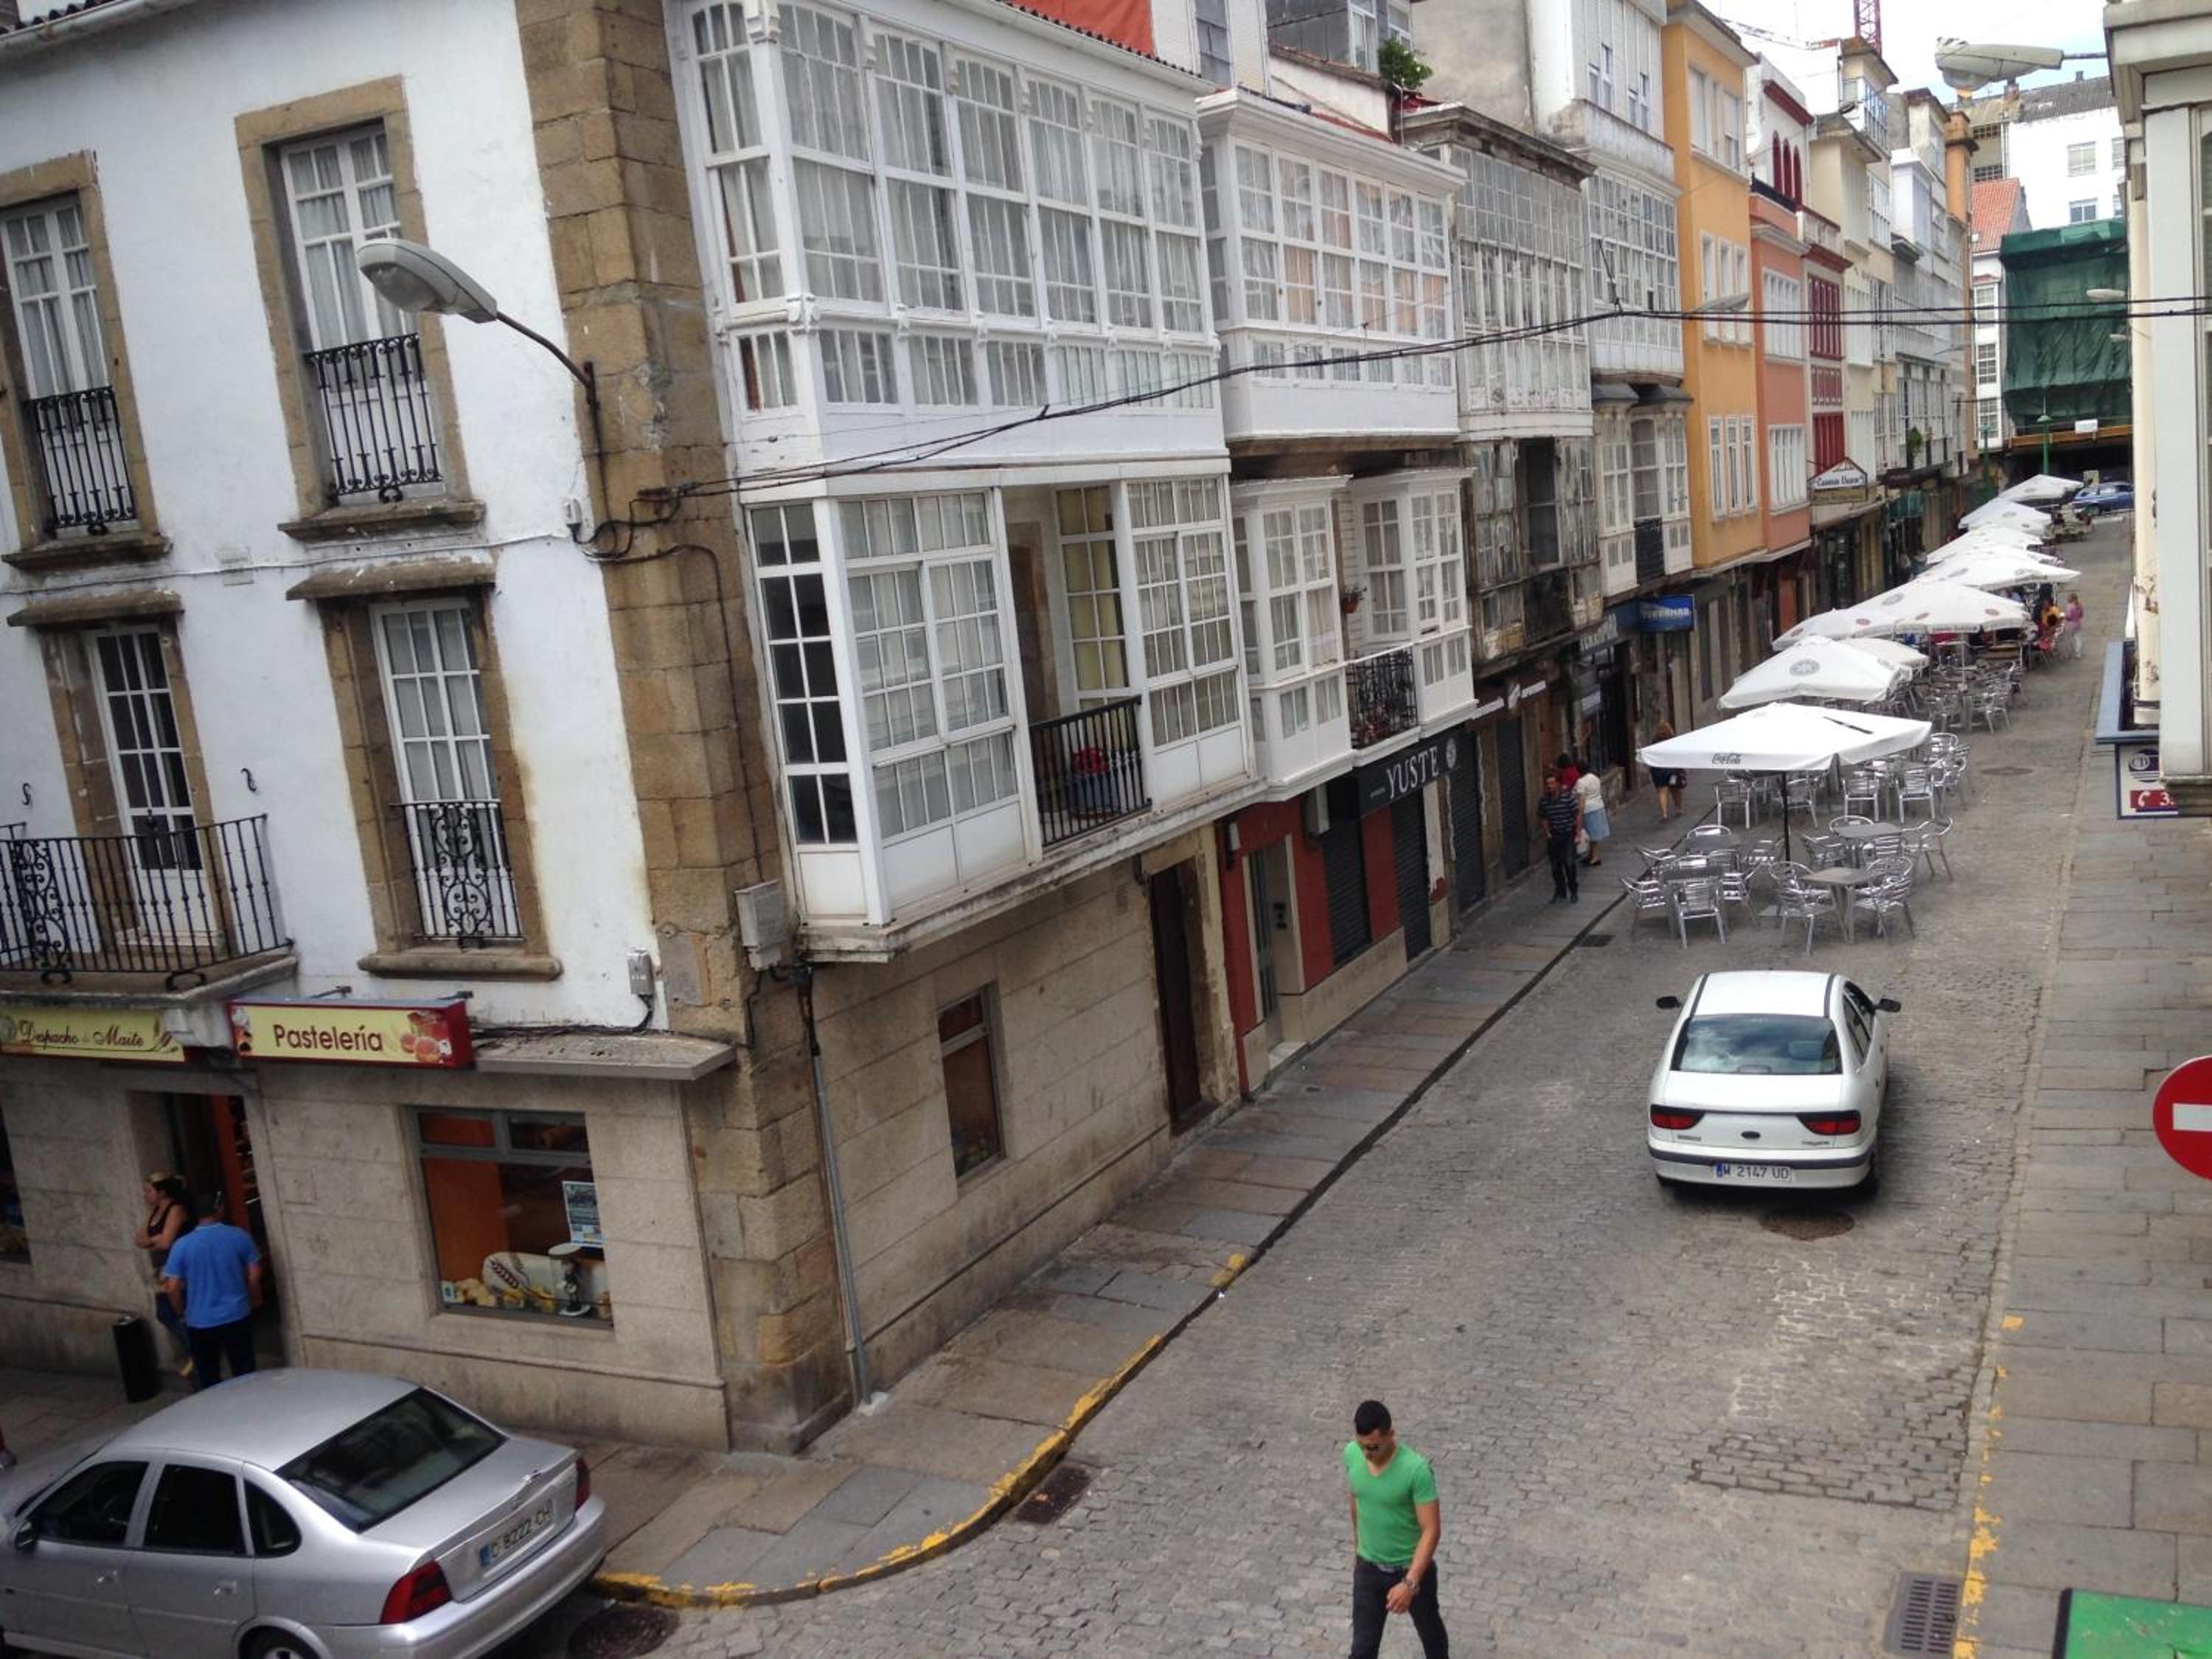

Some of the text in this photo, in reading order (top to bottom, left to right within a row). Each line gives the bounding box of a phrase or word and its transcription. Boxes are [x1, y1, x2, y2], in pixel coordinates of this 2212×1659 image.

[1387, 745, 1439, 799] YUSTE
[93, 1025, 143, 1047] Maite
[273, 1023, 383, 1051] Pastelería
[1737, 1166, 1767, 1178] 2147
